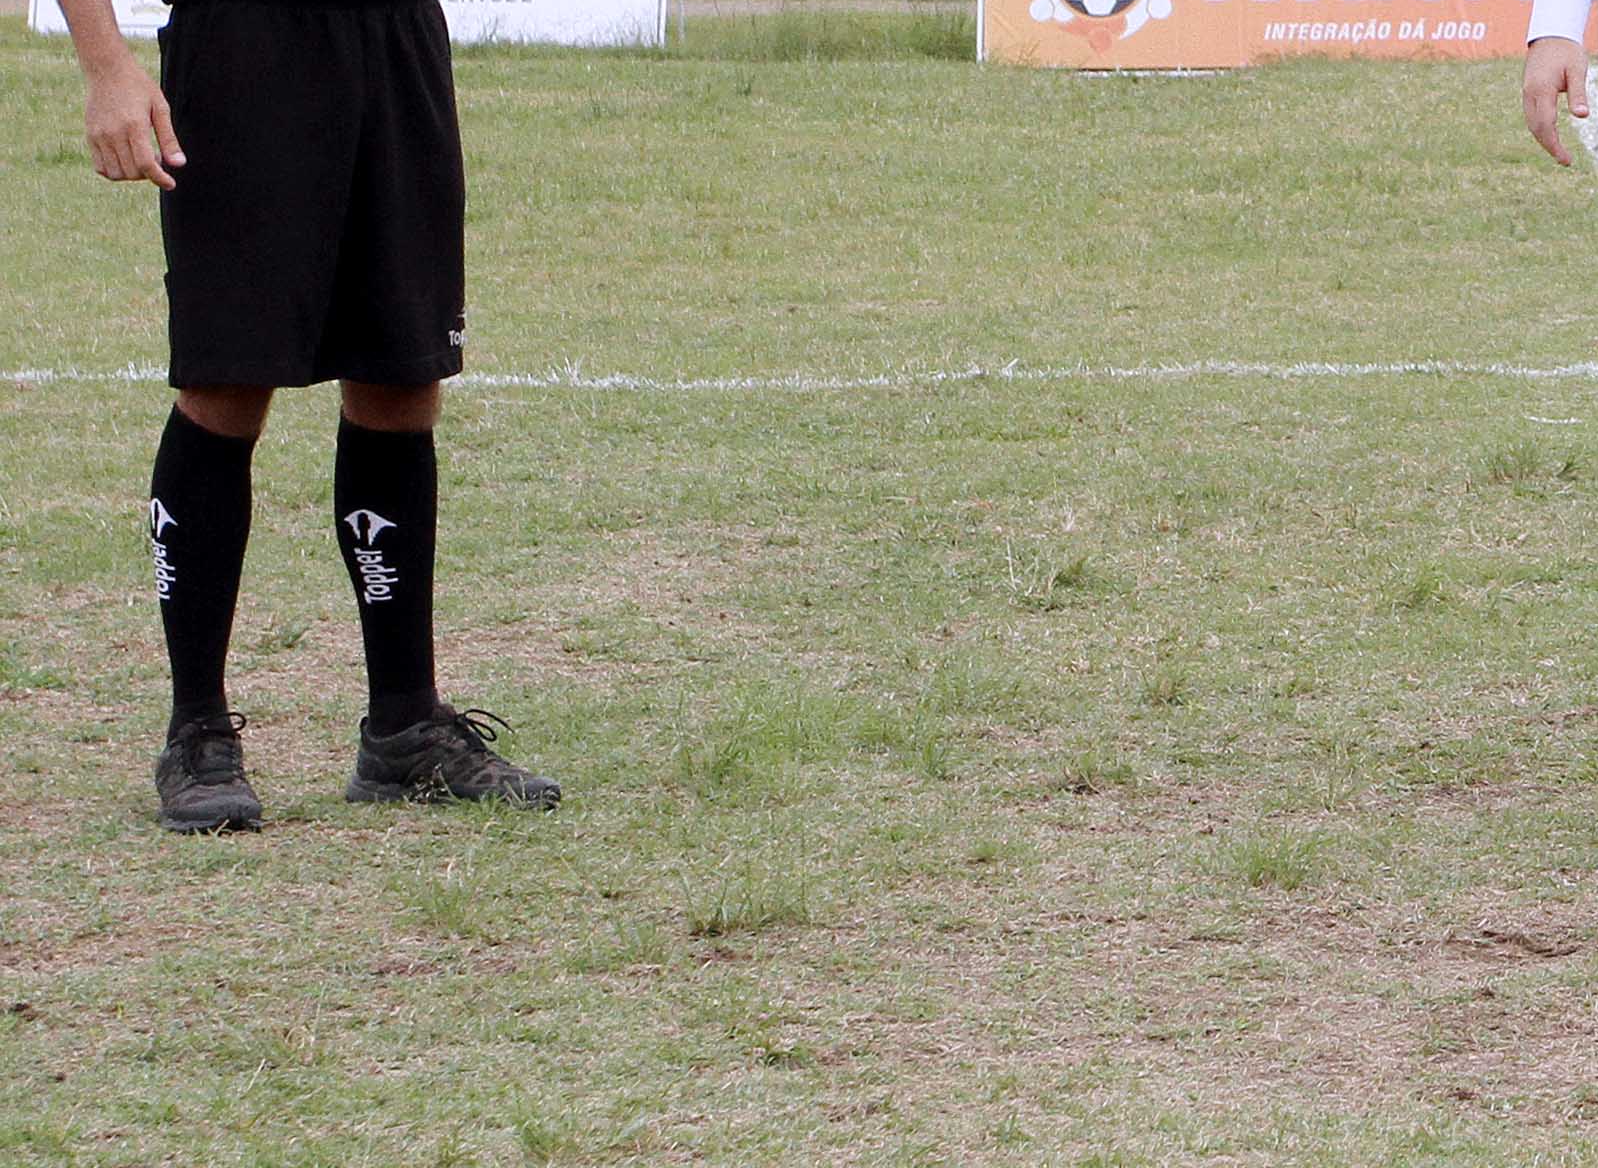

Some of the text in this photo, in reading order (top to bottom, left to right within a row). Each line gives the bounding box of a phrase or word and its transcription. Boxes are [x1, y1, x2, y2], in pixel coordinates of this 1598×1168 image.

[1263, 17, 1486, 44] INTEGRAÇÃO DÁ JOGO
[353, 547, 399, 605] Topper
